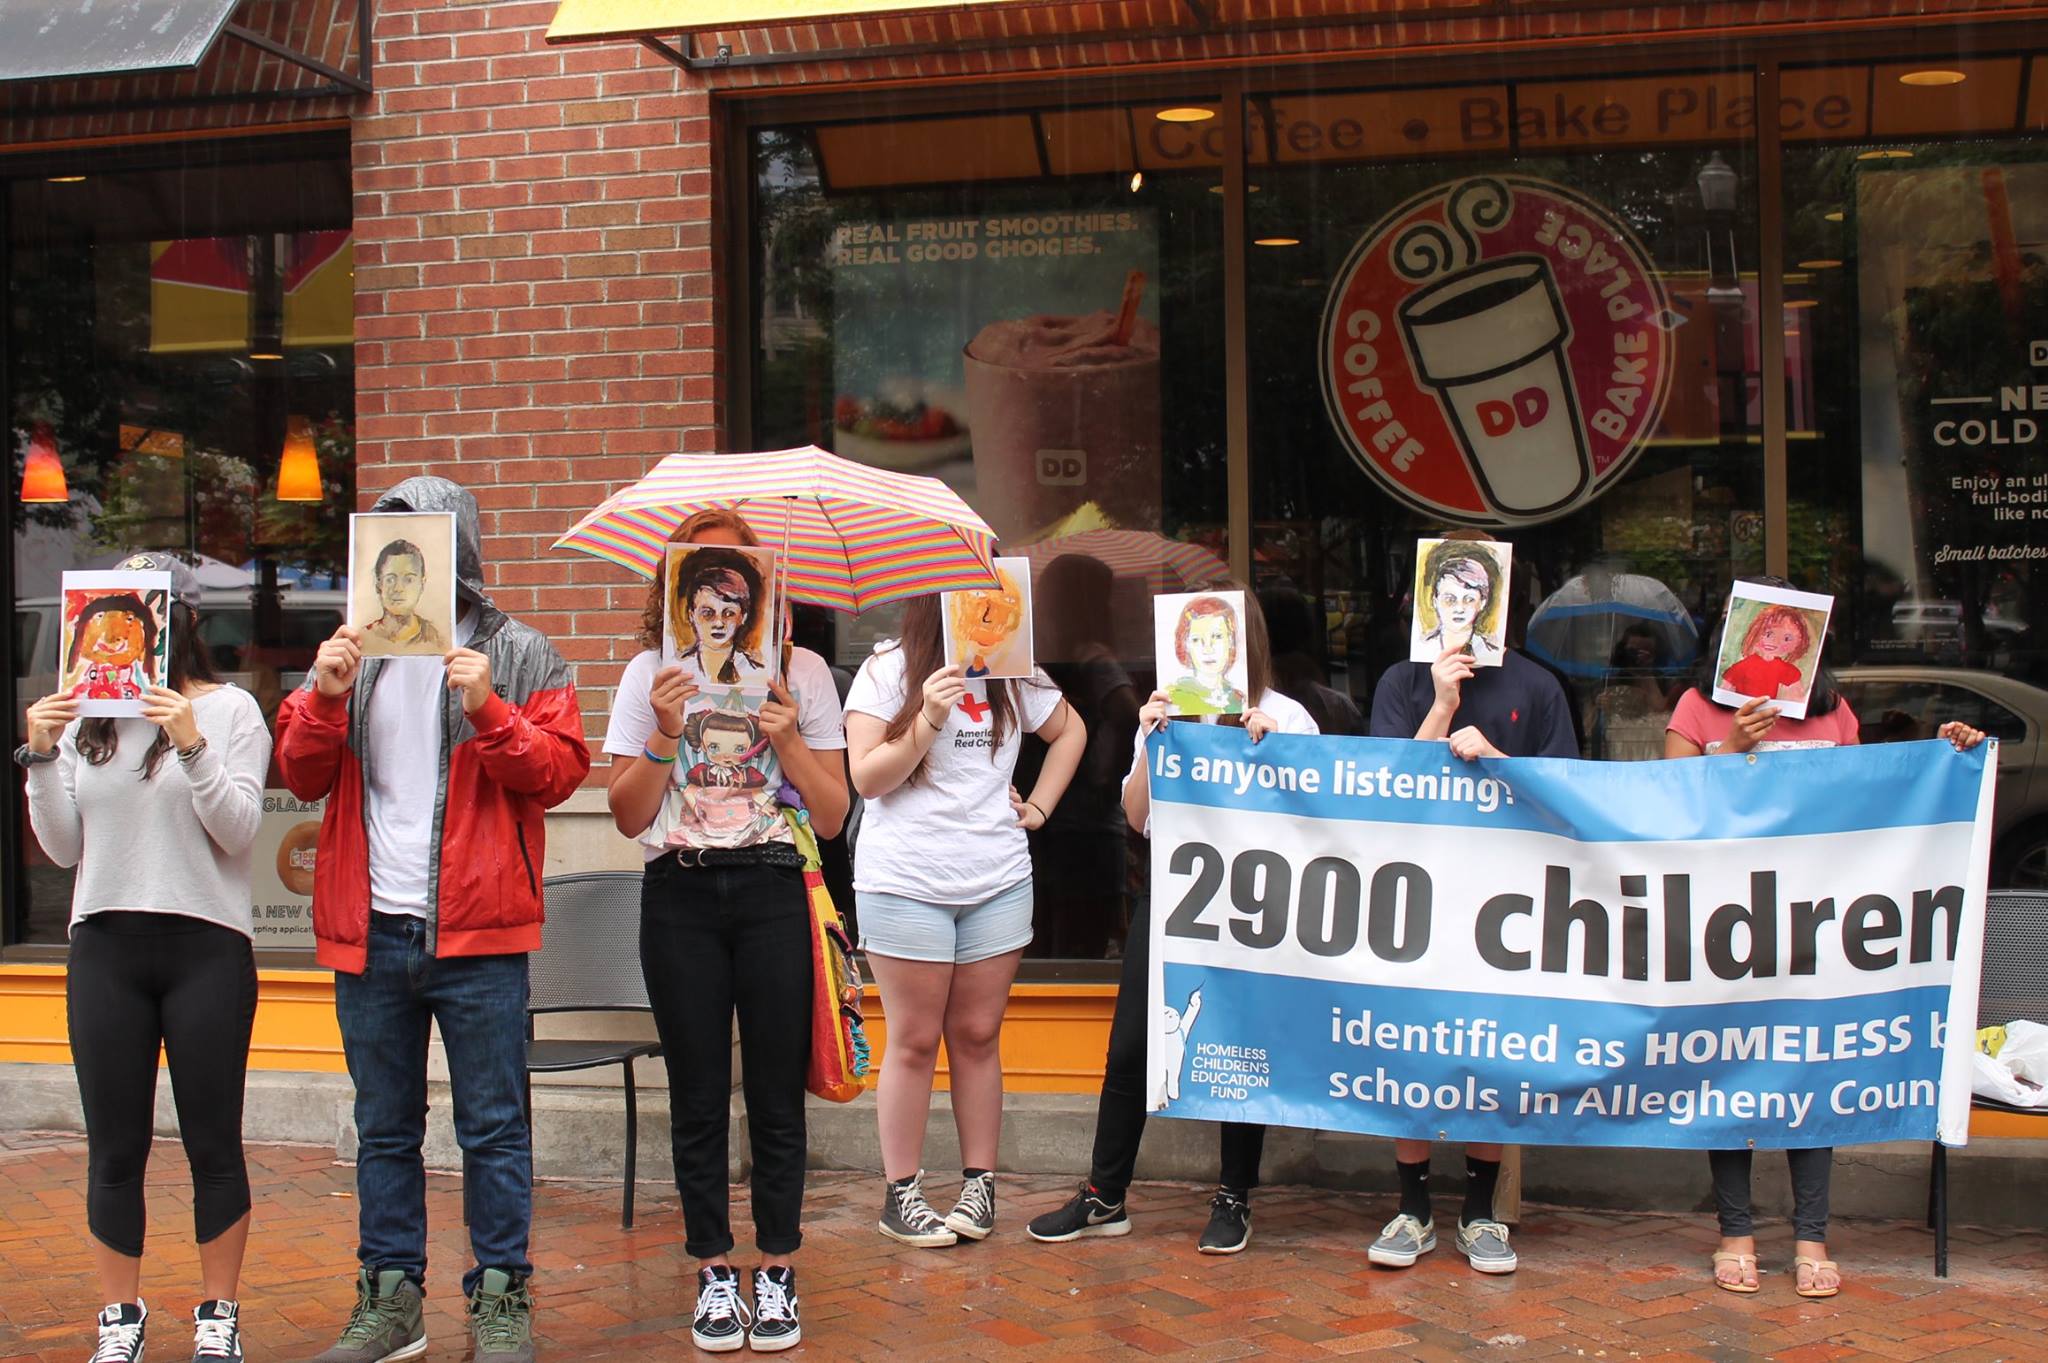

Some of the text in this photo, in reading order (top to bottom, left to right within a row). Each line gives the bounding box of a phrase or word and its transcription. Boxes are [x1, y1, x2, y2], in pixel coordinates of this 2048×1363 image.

[1460, 93, 1631, 143] Bake
[1656, 85, 1852, 133] Place
[837, 213, 1138, 245] REAL FRUIT SMOOTHIES.
[837, 236, 1101, 266] REAL GOOD CHOICES.
[1535, 209, 1649, 441] BAKE PLACE
[1344, 309, 1424, 473] COFFEE
[1475, 386, 1549, 438] DD
[1933, 419, 2038, 446] COLD
[1041, 457, 1082, 478] DD
[1952, 475, 2000, 490] Enjoy
[2005, 477, 2026, 488] an
[1994, 507, 2025, 520] like
[1934, 544, 1985, 566] Small
[954, 739, 1004, 747] Red Cros
[1156, 746, 1181, 779] Is
[1190, 756, 1320, 795] anyone
[262, 796, 320, 812] GLAZE
[265, 904, 302, 918] NEW
[1165, 841, 1965, 982] 2900 children
[1331, 1007, 1558, 1063] identified
[1574, 1036, 1625, 1068] as
[1644, 1014, 1912, 1066] HOMELESS
[1197, 1043, 1266, 1060] HOMELESS
[1192, 1056, 1270, 1074] CHILDREN'S
[1191, 1070, 1269, 1088] EDUCATION
[1210, 1086, 1248, 1100] FUND
[1328, 1067, 1942, 1128] schools in Allegheny Coun
